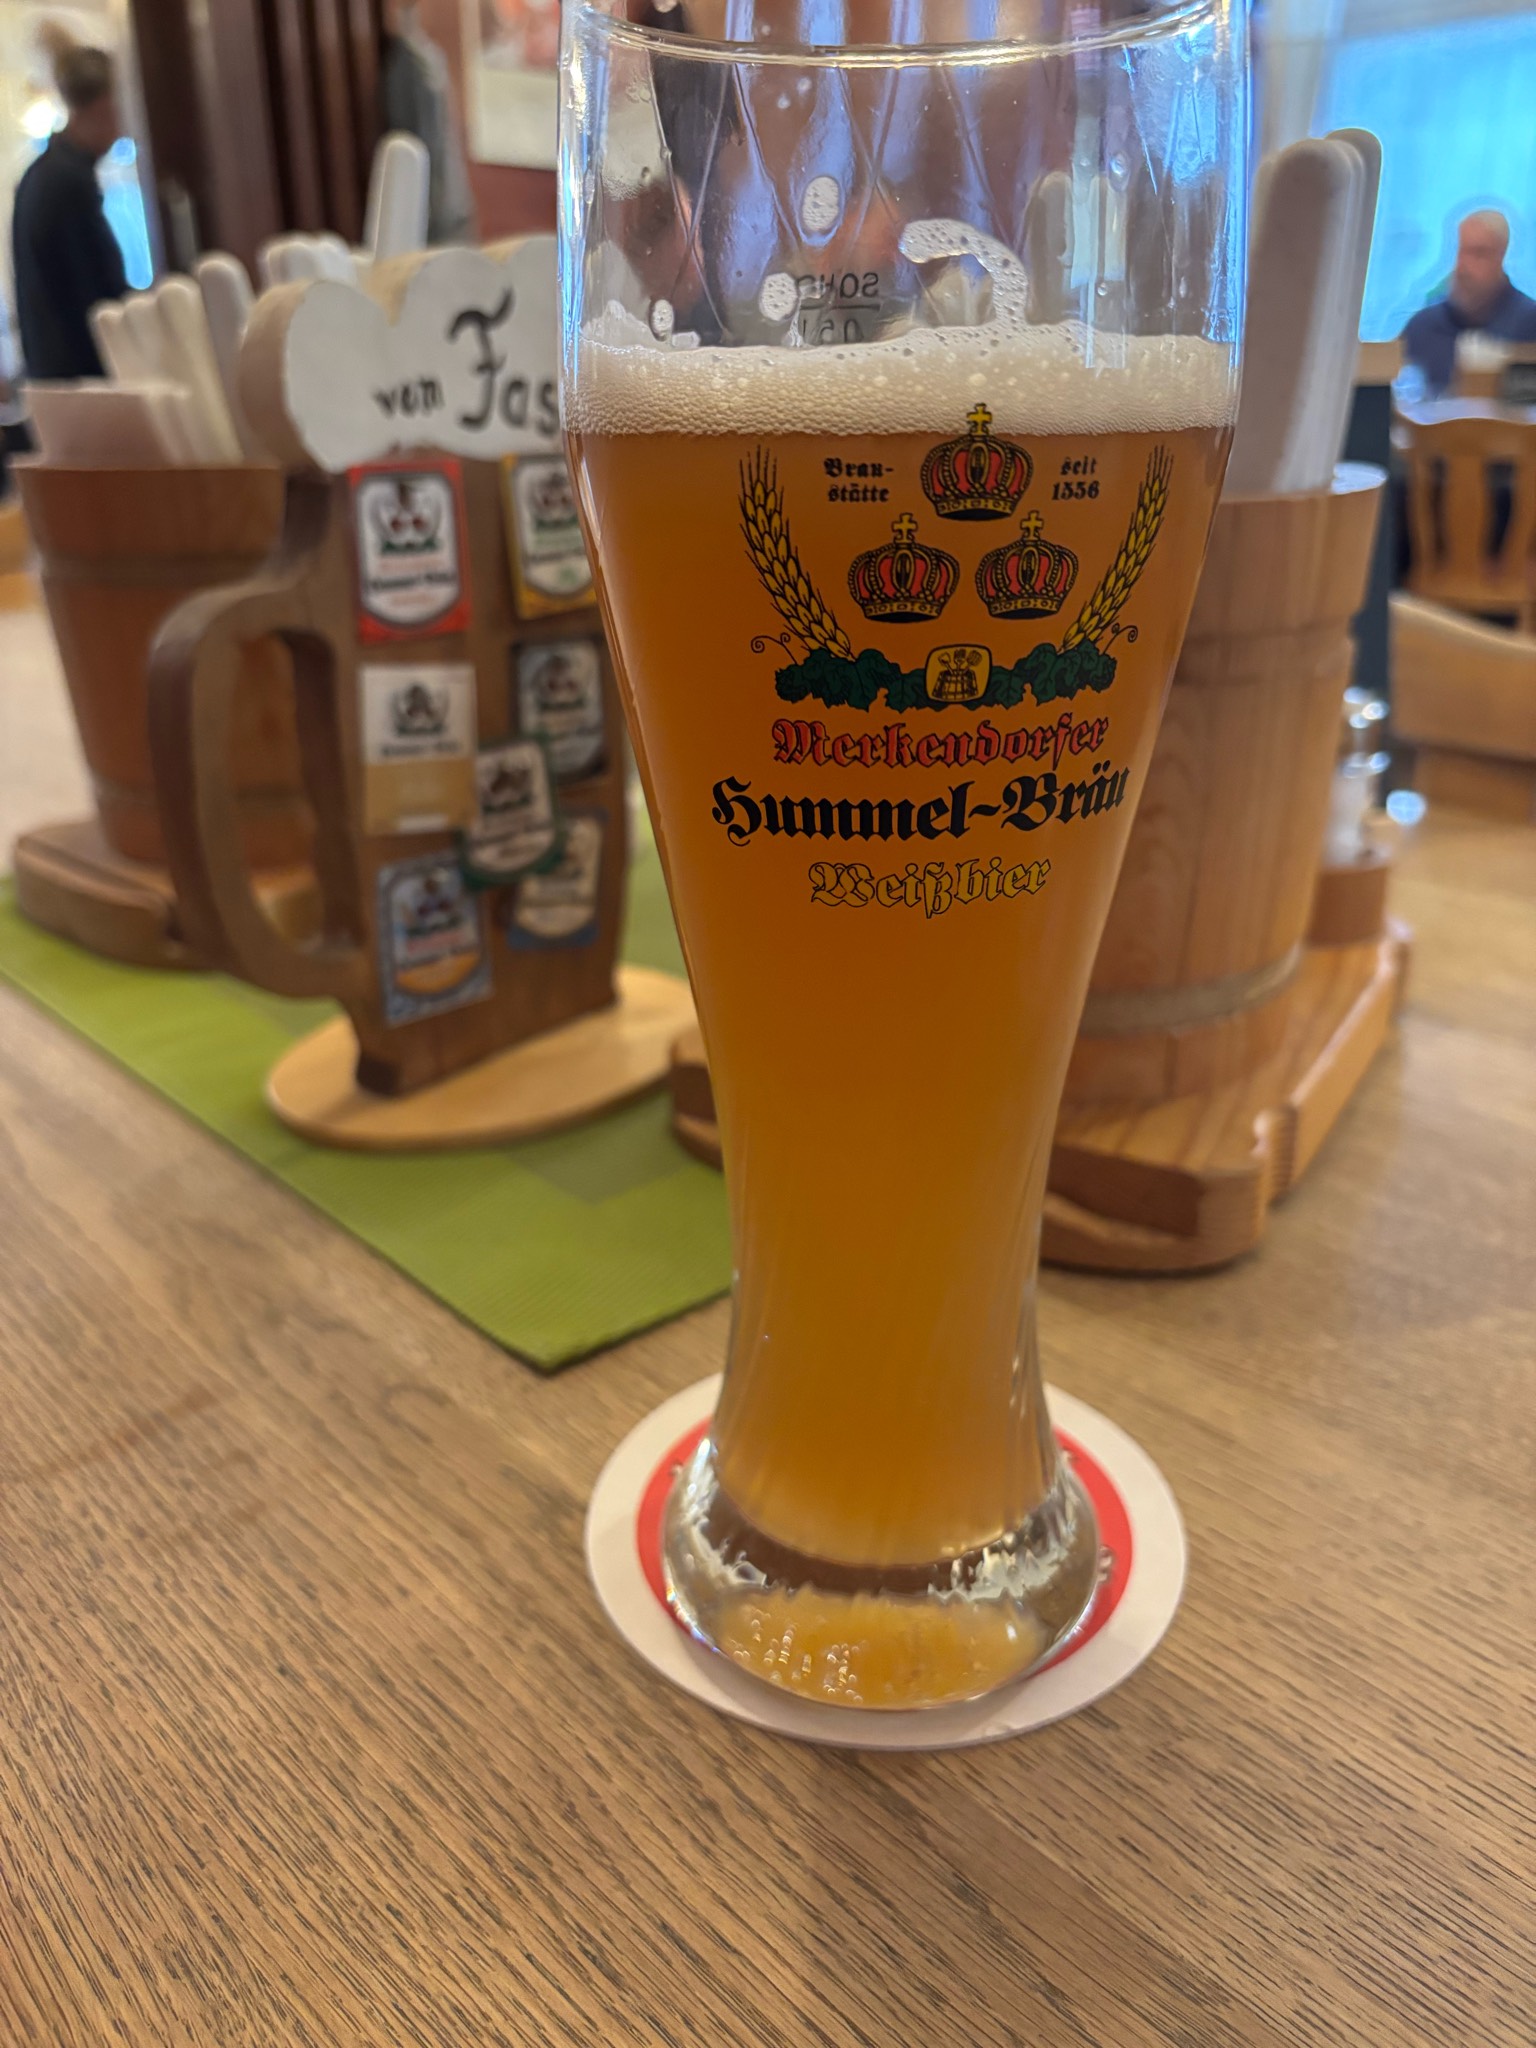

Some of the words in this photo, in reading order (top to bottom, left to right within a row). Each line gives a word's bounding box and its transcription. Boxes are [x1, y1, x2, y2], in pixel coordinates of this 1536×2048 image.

[446, 286, 559, 438] Fas
[823, 457, 894, 478] Brau-
[828, 483, 890, 502] stätte
[1060, 455, 1097, 476] seit
[771, 711, 1110, 771] Merkendorfer
[711, 759, 1131, 847] Hummel-Bräu
[808, 856, 1052, 919] Weißbier
